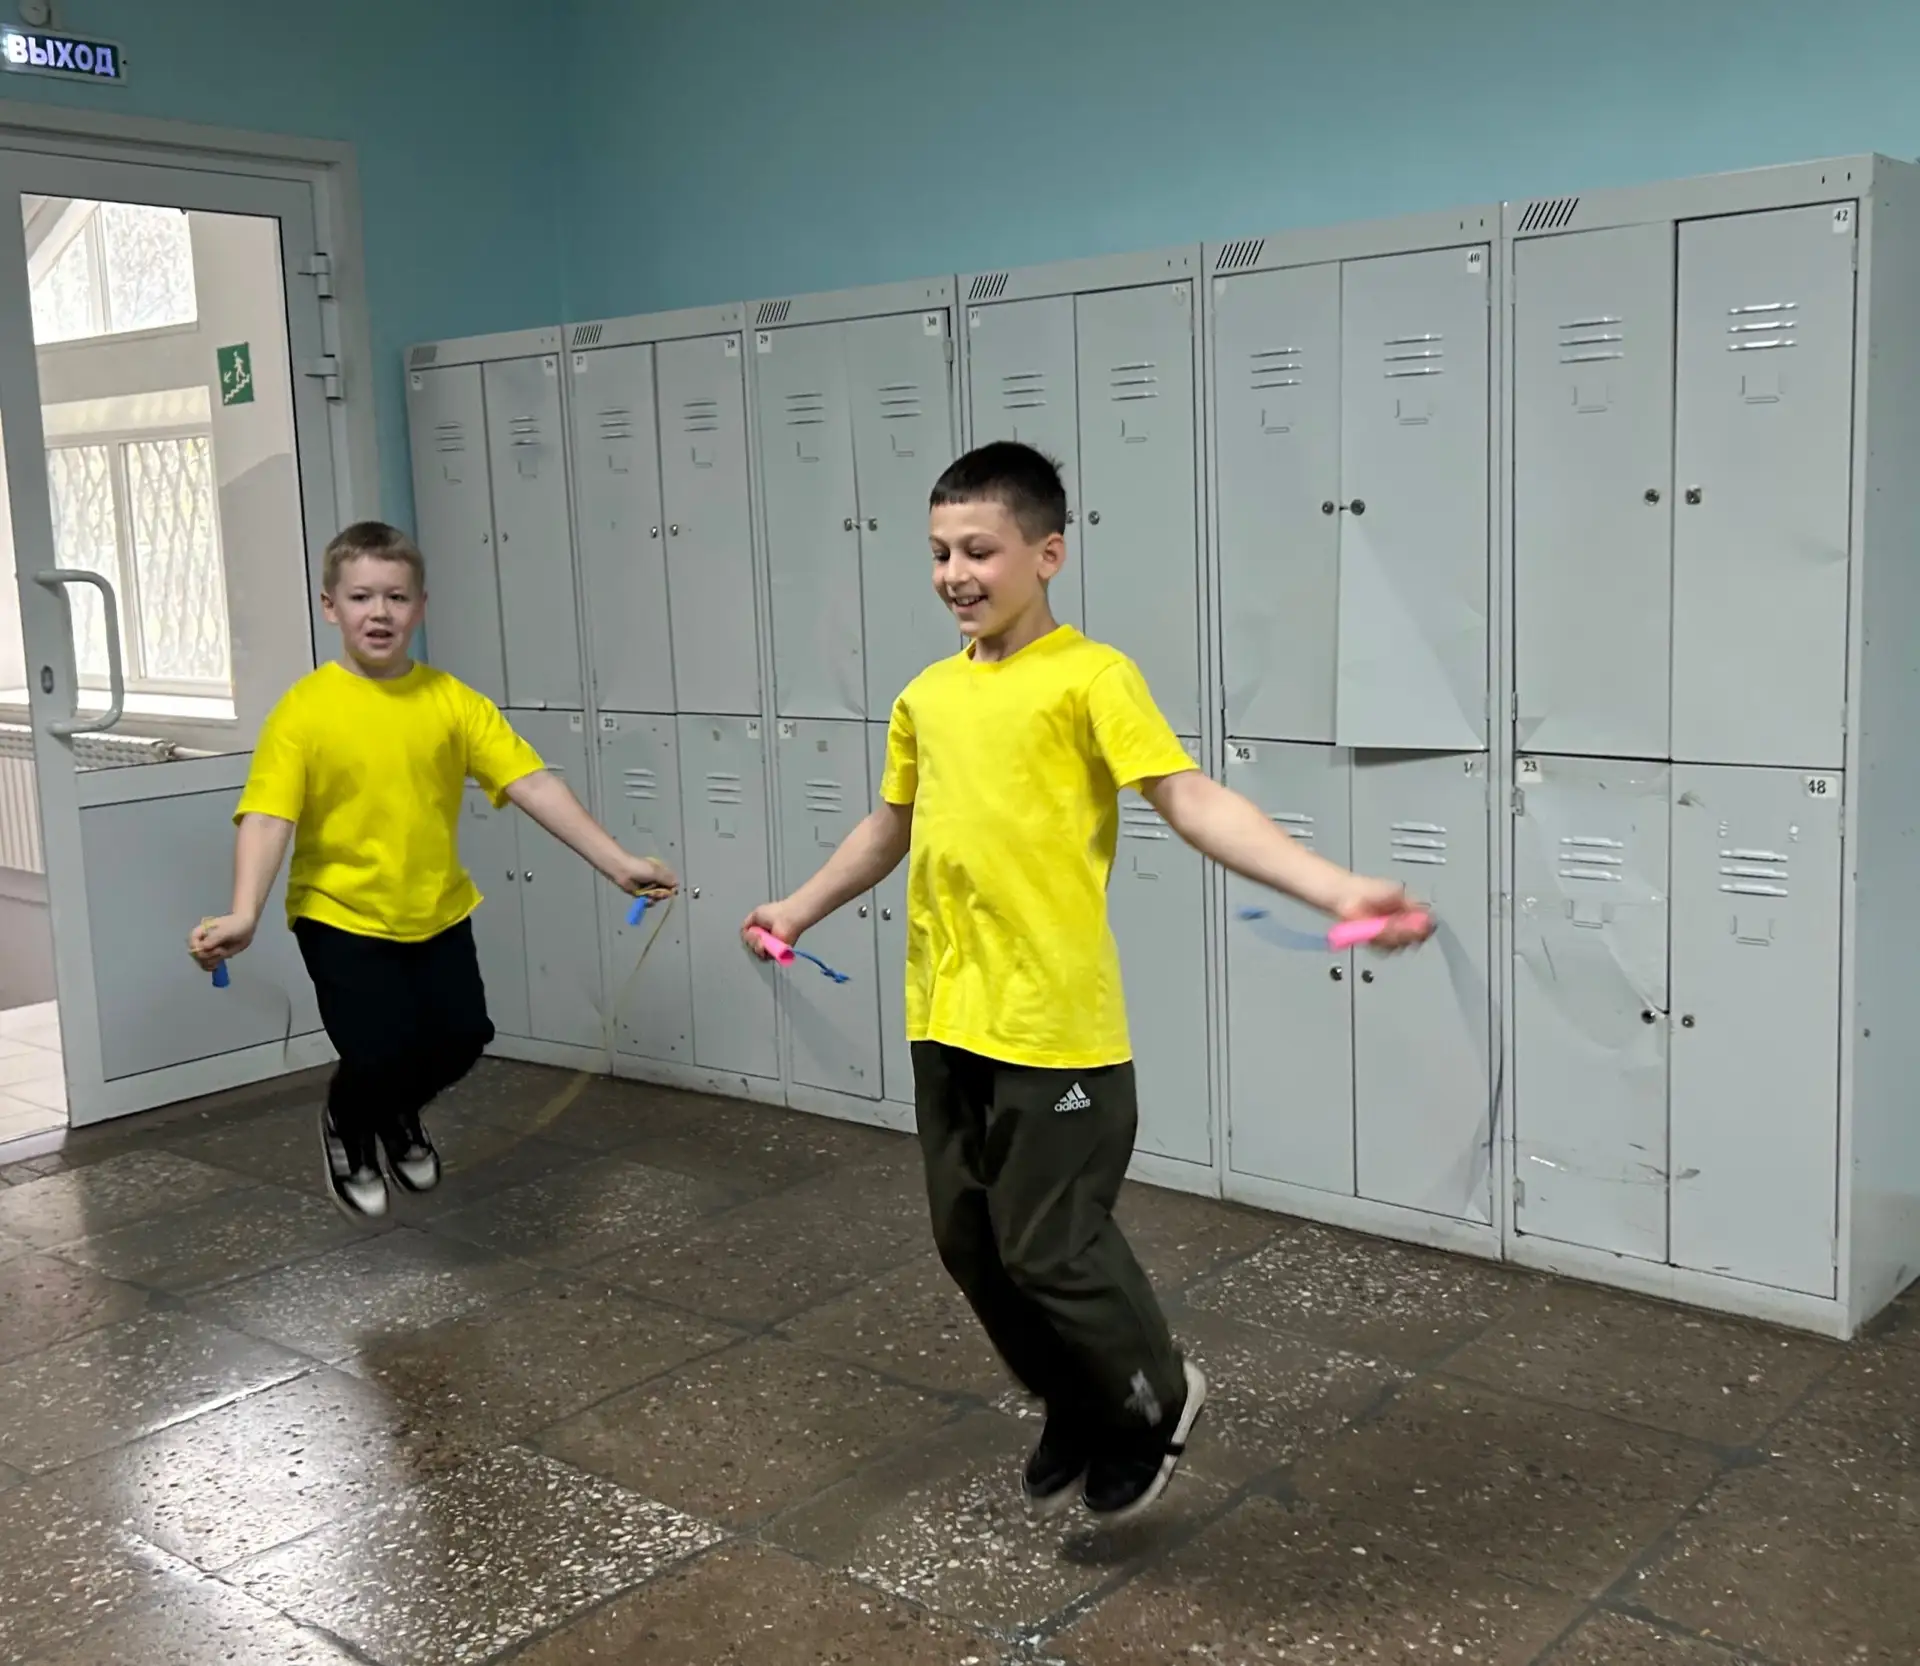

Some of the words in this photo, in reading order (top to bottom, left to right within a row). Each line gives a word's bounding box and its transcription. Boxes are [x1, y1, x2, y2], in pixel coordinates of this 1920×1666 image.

[7, 33, 116, 77] ВЫХОД
[1833, 209, 1849, 222] 42
[1467, 252, 1480, 264] 40
[1235, 747, 1250, 760] 45
[1522, 760, 1537, 773] 23
[1808, 779, 1826, 795] 48
[1054, 1098, 1091, 1112] adidas
